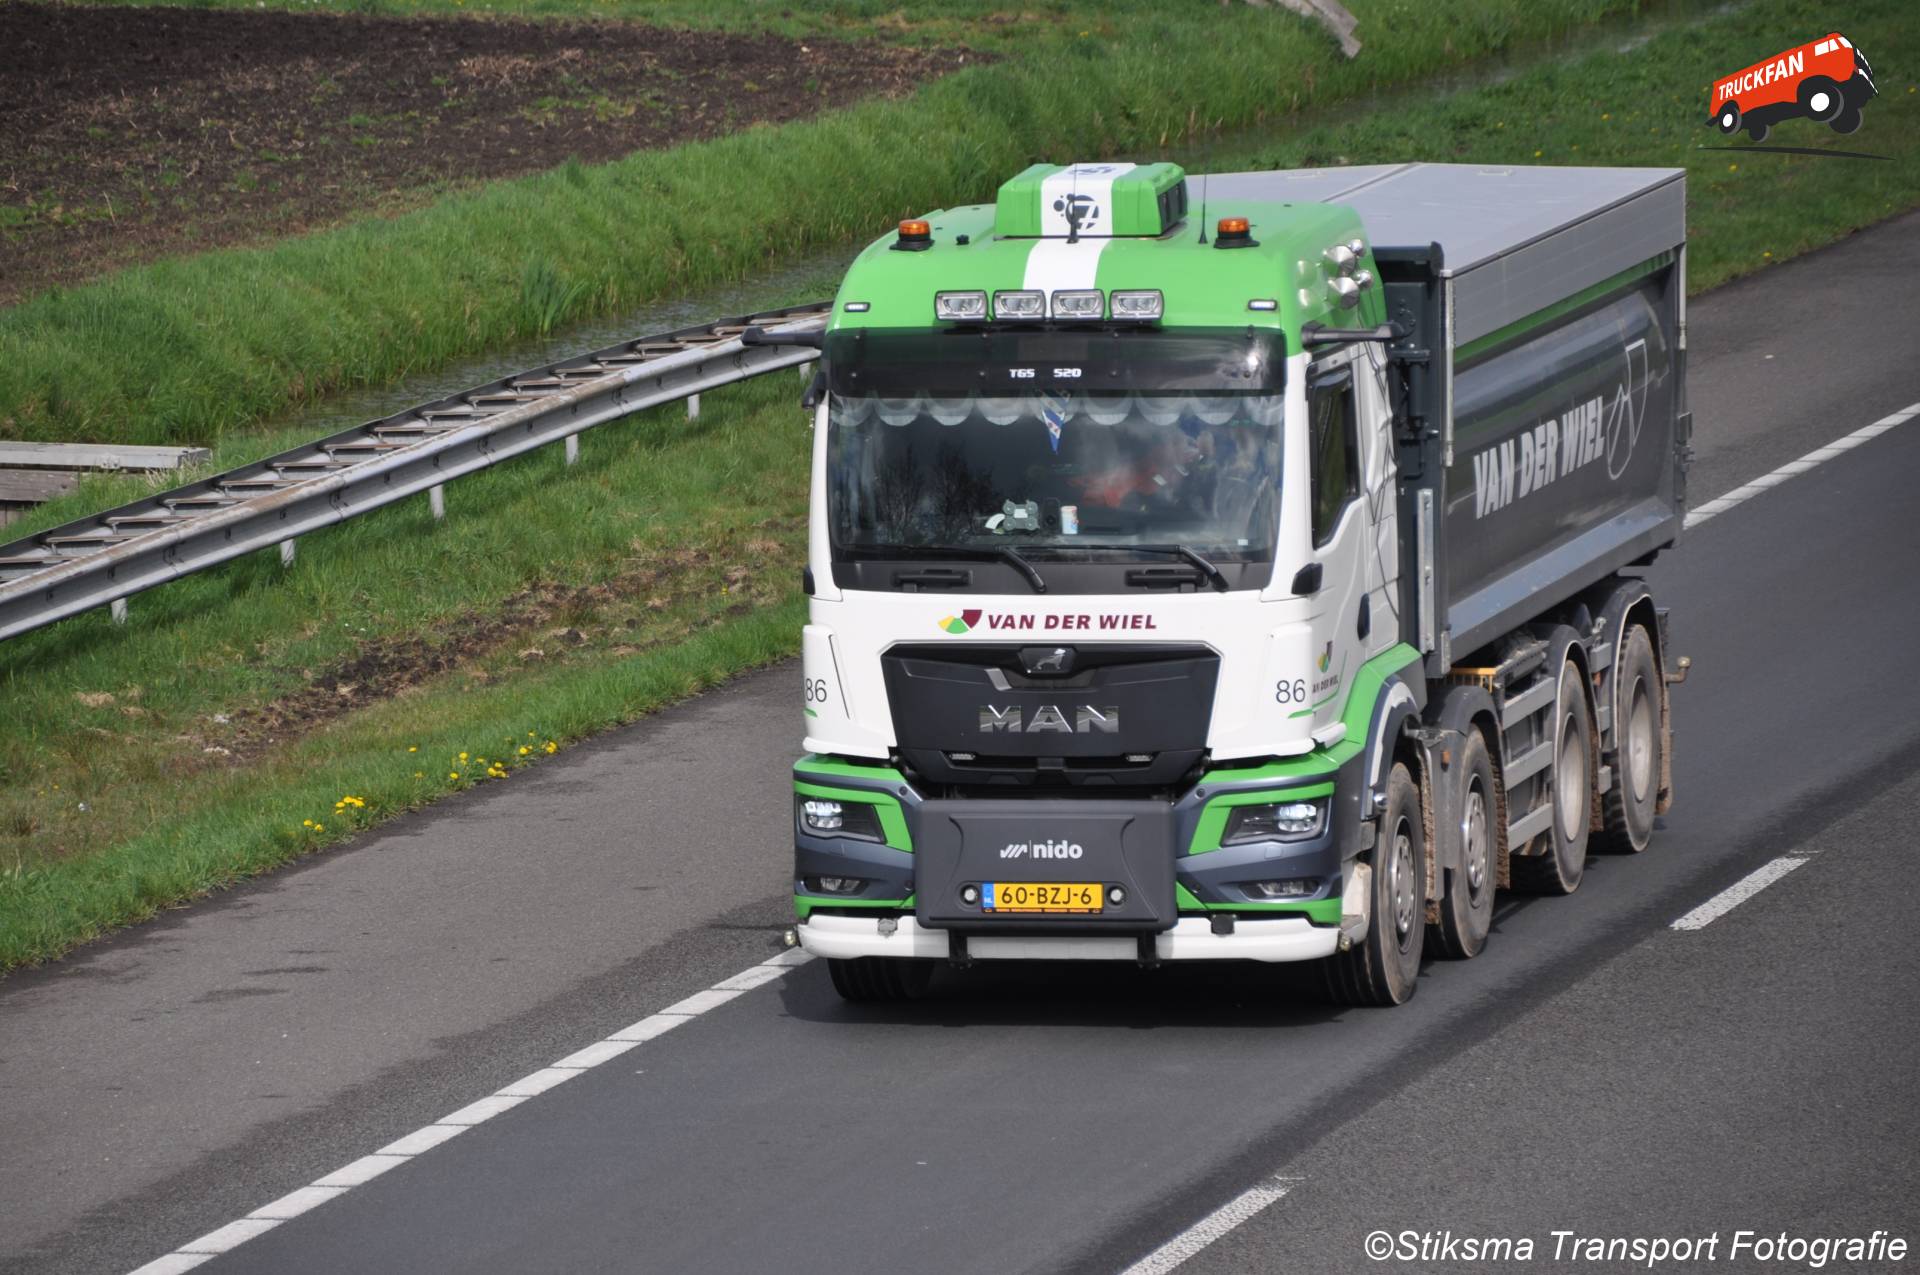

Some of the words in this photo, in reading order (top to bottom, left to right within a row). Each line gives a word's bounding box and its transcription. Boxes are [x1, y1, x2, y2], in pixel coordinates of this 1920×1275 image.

[1009, 368, 1036, 378] TGS
[1053, 368, 1082, 378] 520
[1474, 439, 1515, 520] VAN
[1519, 419, 1559, 499] DER
[1561, 396, 1605, 477] WIEL
[988, 614, 1035, 630] VAN
[1044, 614, 1091, 630] DER
[1100, 614, 1157, 630] WIEL
[805, 678, 827, 702] 86
[1276, 679, 1306, 703] 86
[979, 704, 1120, 733] MAN
[1032, 840, 1083, 859] nido
[1001, 886, 1092, 905] 60-BZJ-6
